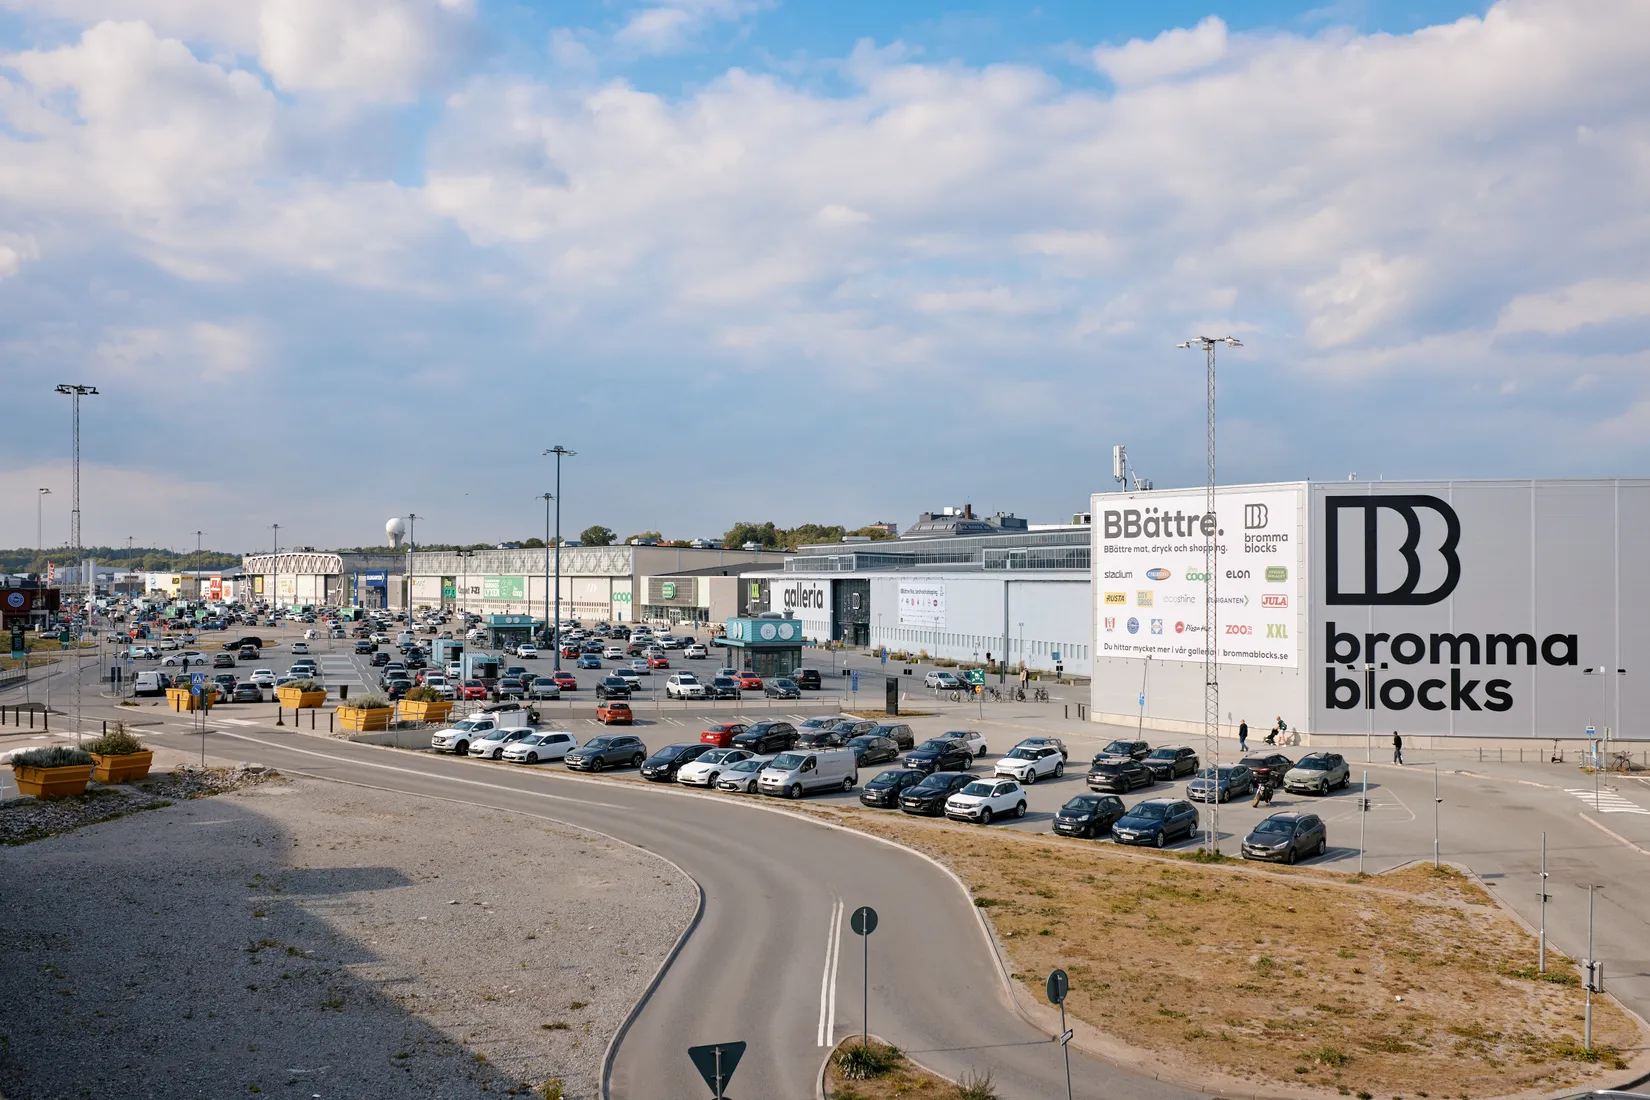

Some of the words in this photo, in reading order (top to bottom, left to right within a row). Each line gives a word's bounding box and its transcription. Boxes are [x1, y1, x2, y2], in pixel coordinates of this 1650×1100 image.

[1104, 507, 1224, 538] BBättre.
[1244, 533, 1288, 542] bromma
[1104, 545, 1132, 553] BBättre
[1152, 544, 1172, 554] dryck
[1174, 544, 1188, 552] och
[1189, 544, 1228, 554] shoppng.
[1244, 543, 1277, 552] blocks
[1104, 570, 1132, 578] stadium
[612, 592, 632, 604] coop
[784, 582, 824, 608] galleria
[1262, 597, 1287, 606] JULA
[1266, 624, 1288, 638] XXL
[1325, 621, 1578, 666] bromma
[1133, 645, 1156, 653] mycket
[1223, 649, 1288, 660] brommablocks.se
[1325, 667, 1514, 712] blocks
